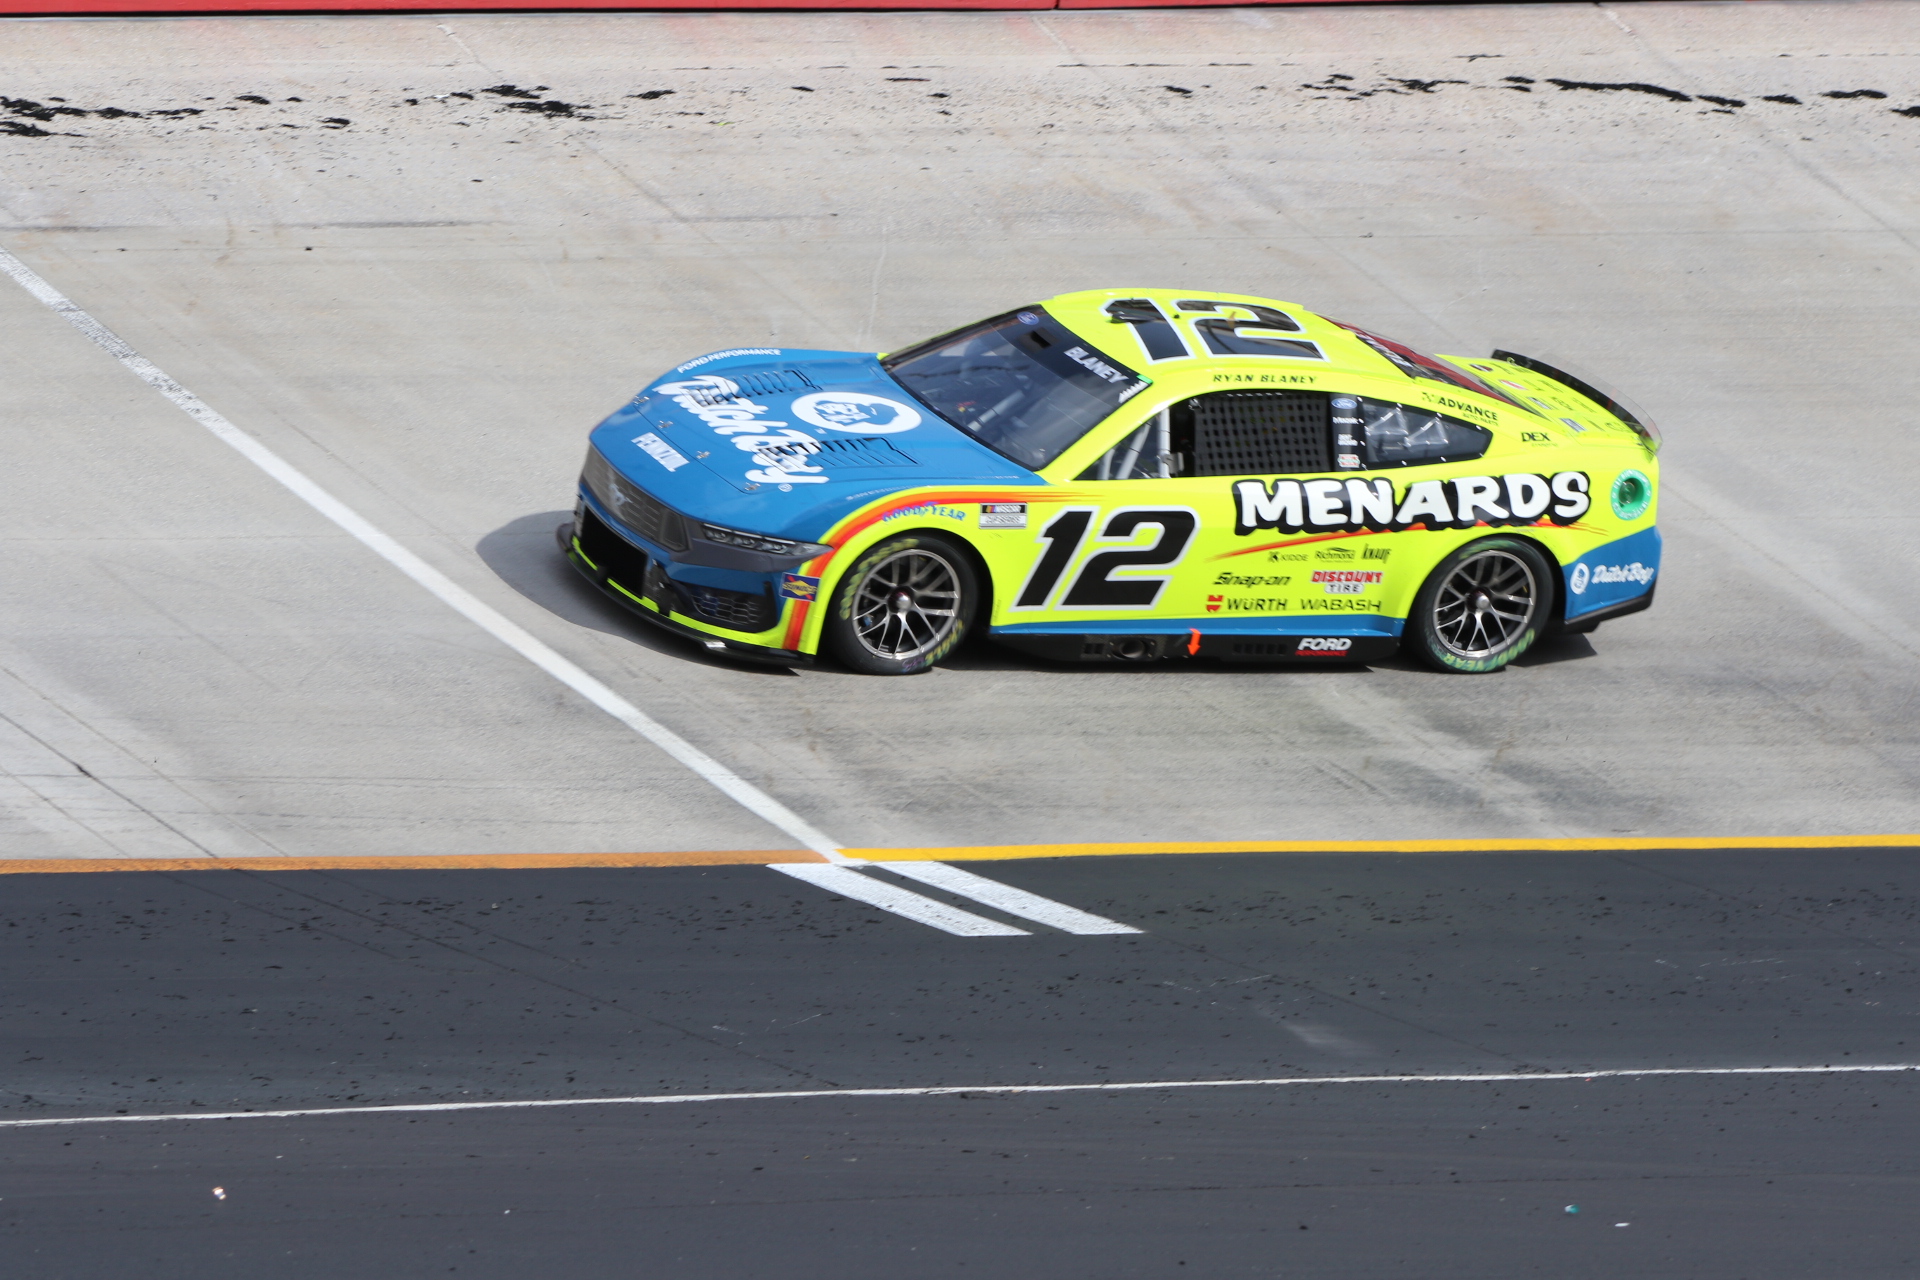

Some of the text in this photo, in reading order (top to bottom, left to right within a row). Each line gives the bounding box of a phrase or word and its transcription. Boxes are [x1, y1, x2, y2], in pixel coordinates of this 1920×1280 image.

[1100, 298, 1330, 364] 12
[677, 357, 709, 374] FORD
[1064, 346, 1129, 384] BLANEY
[1213, 374, 1317, 384] RYAN BLANEY
[1437, 397, 1498, 421] ADVANCE
[1521, 432, 1551, 442] DEX
[1232, 472, 1591, 535] MENARDS
[1008, 505, 1201, 612] 12
[1281, 553, 1309, 562] KIDDE
[1314, 549, 1356, 560] Richmond
[1213, 572, 1291, 588] Snap-on
[1310, 570, 1384, 583] DISCOUNT
[1591, 562, 1654, 585] Dutch Boy
[1328, 584, 1361, 592] TIRE
[1300, 598, 1382, 612] WABASH
[1297, 637, 1352, 650] FORD
